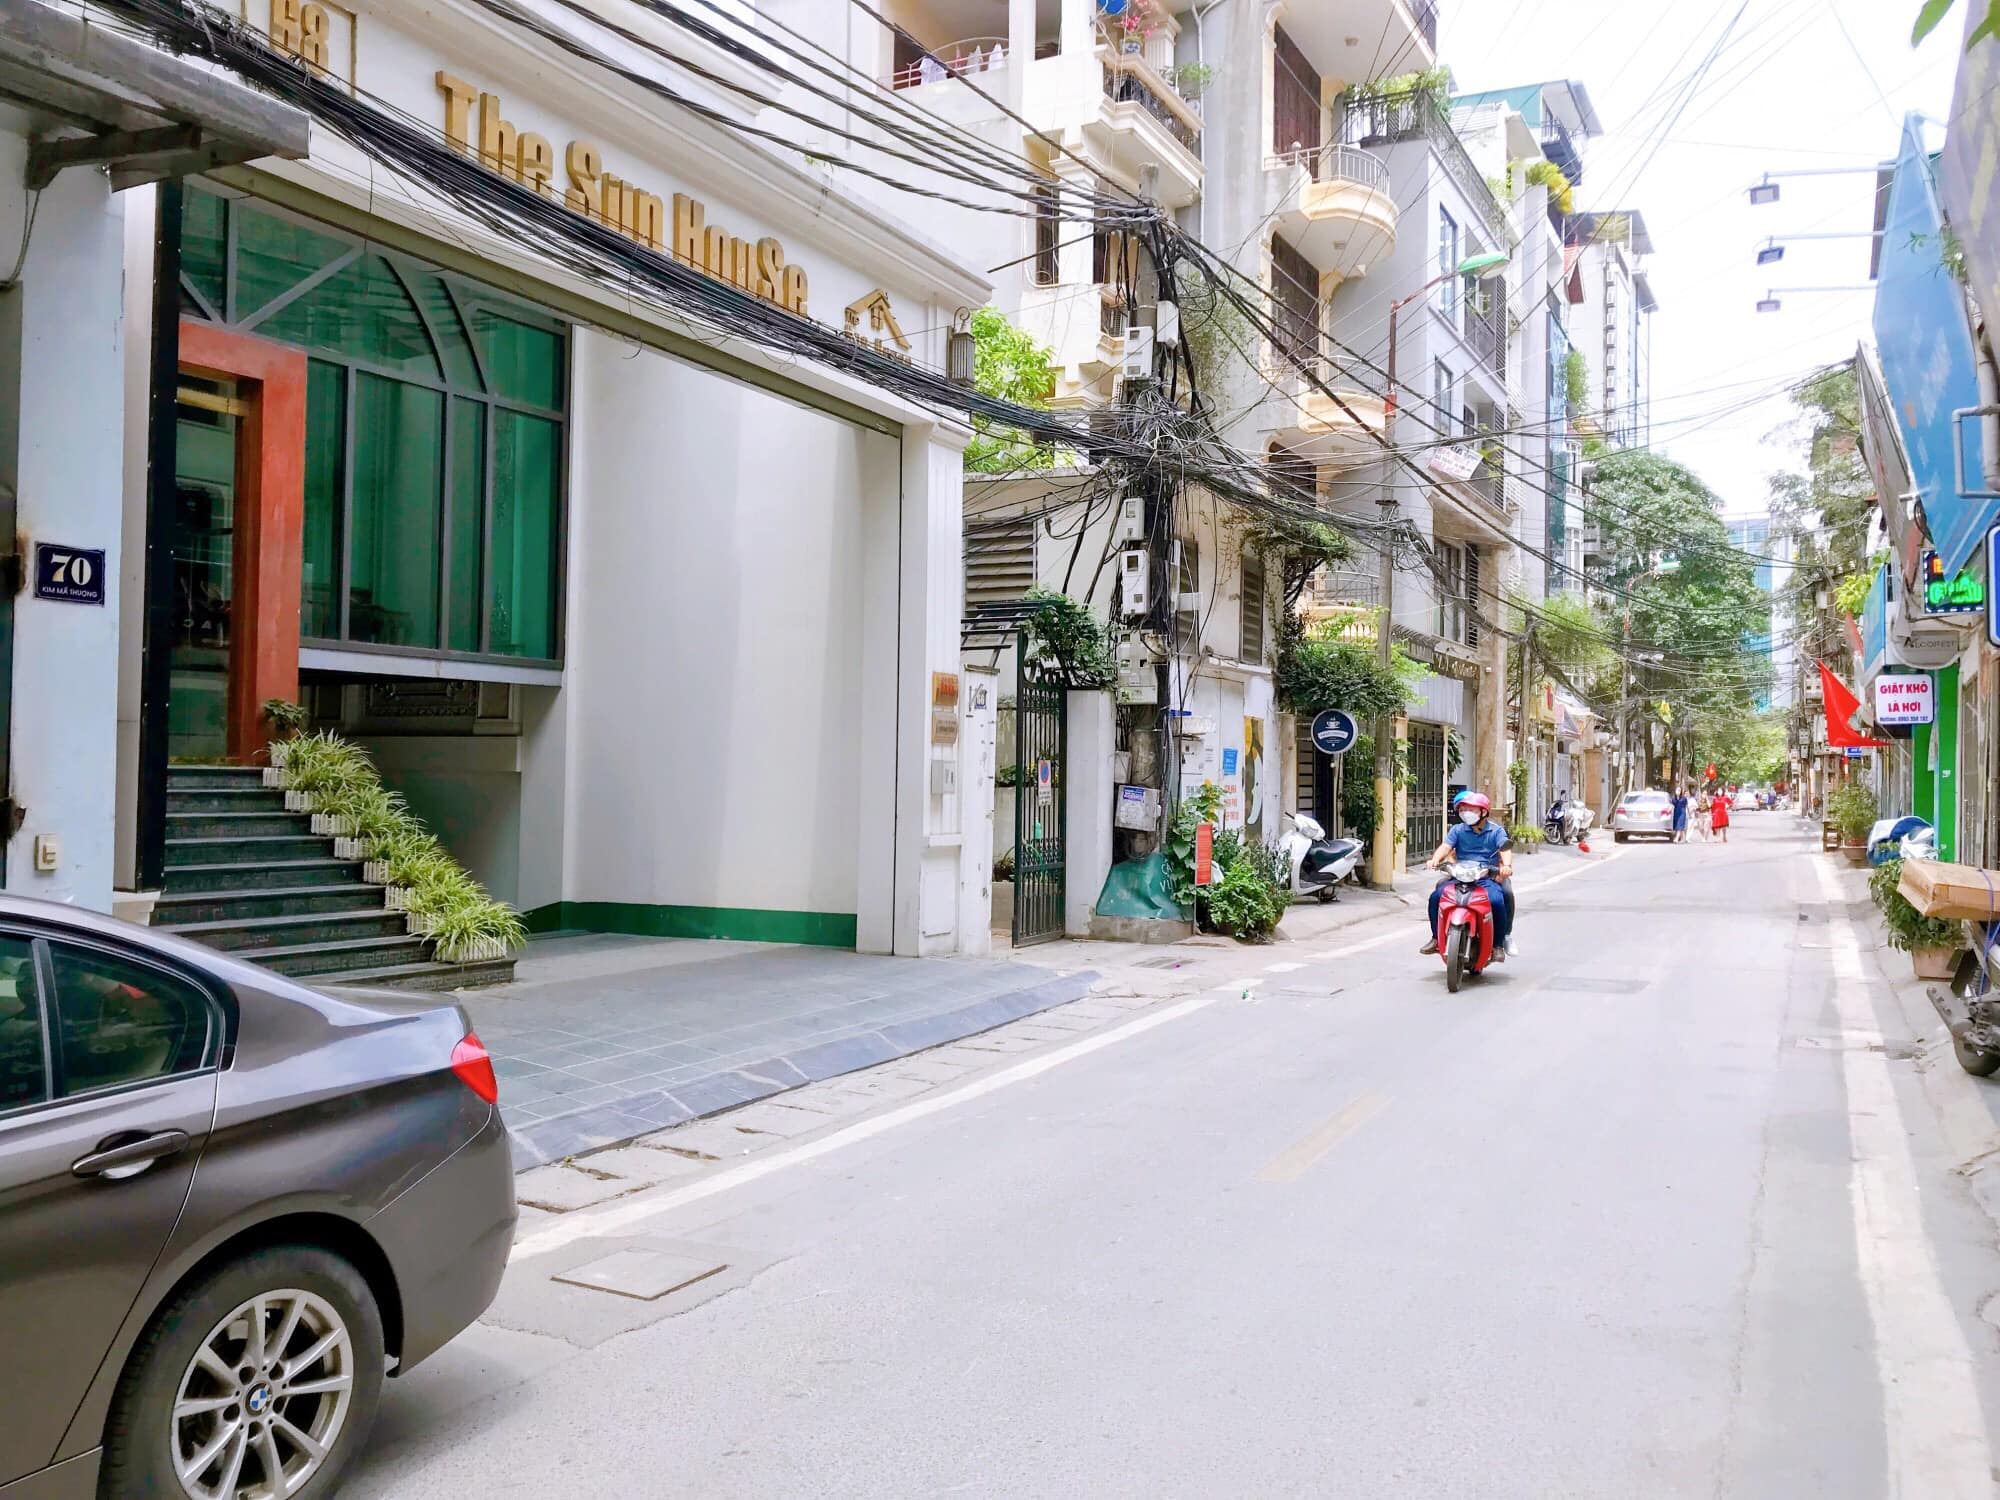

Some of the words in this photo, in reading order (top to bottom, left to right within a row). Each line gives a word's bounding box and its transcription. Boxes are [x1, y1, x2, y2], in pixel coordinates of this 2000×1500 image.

[435, 70, 553, 202] The
[565, 140, 663, 252] Sun
[51, 553, 92, 586] 70
[56, 586, 69, 595] MÃ
[1906, 680, 1929, 693] KHÔ
[1888, 700, 1900, 713] LÀ
[1902, 701, 1922, 712] HƠI
